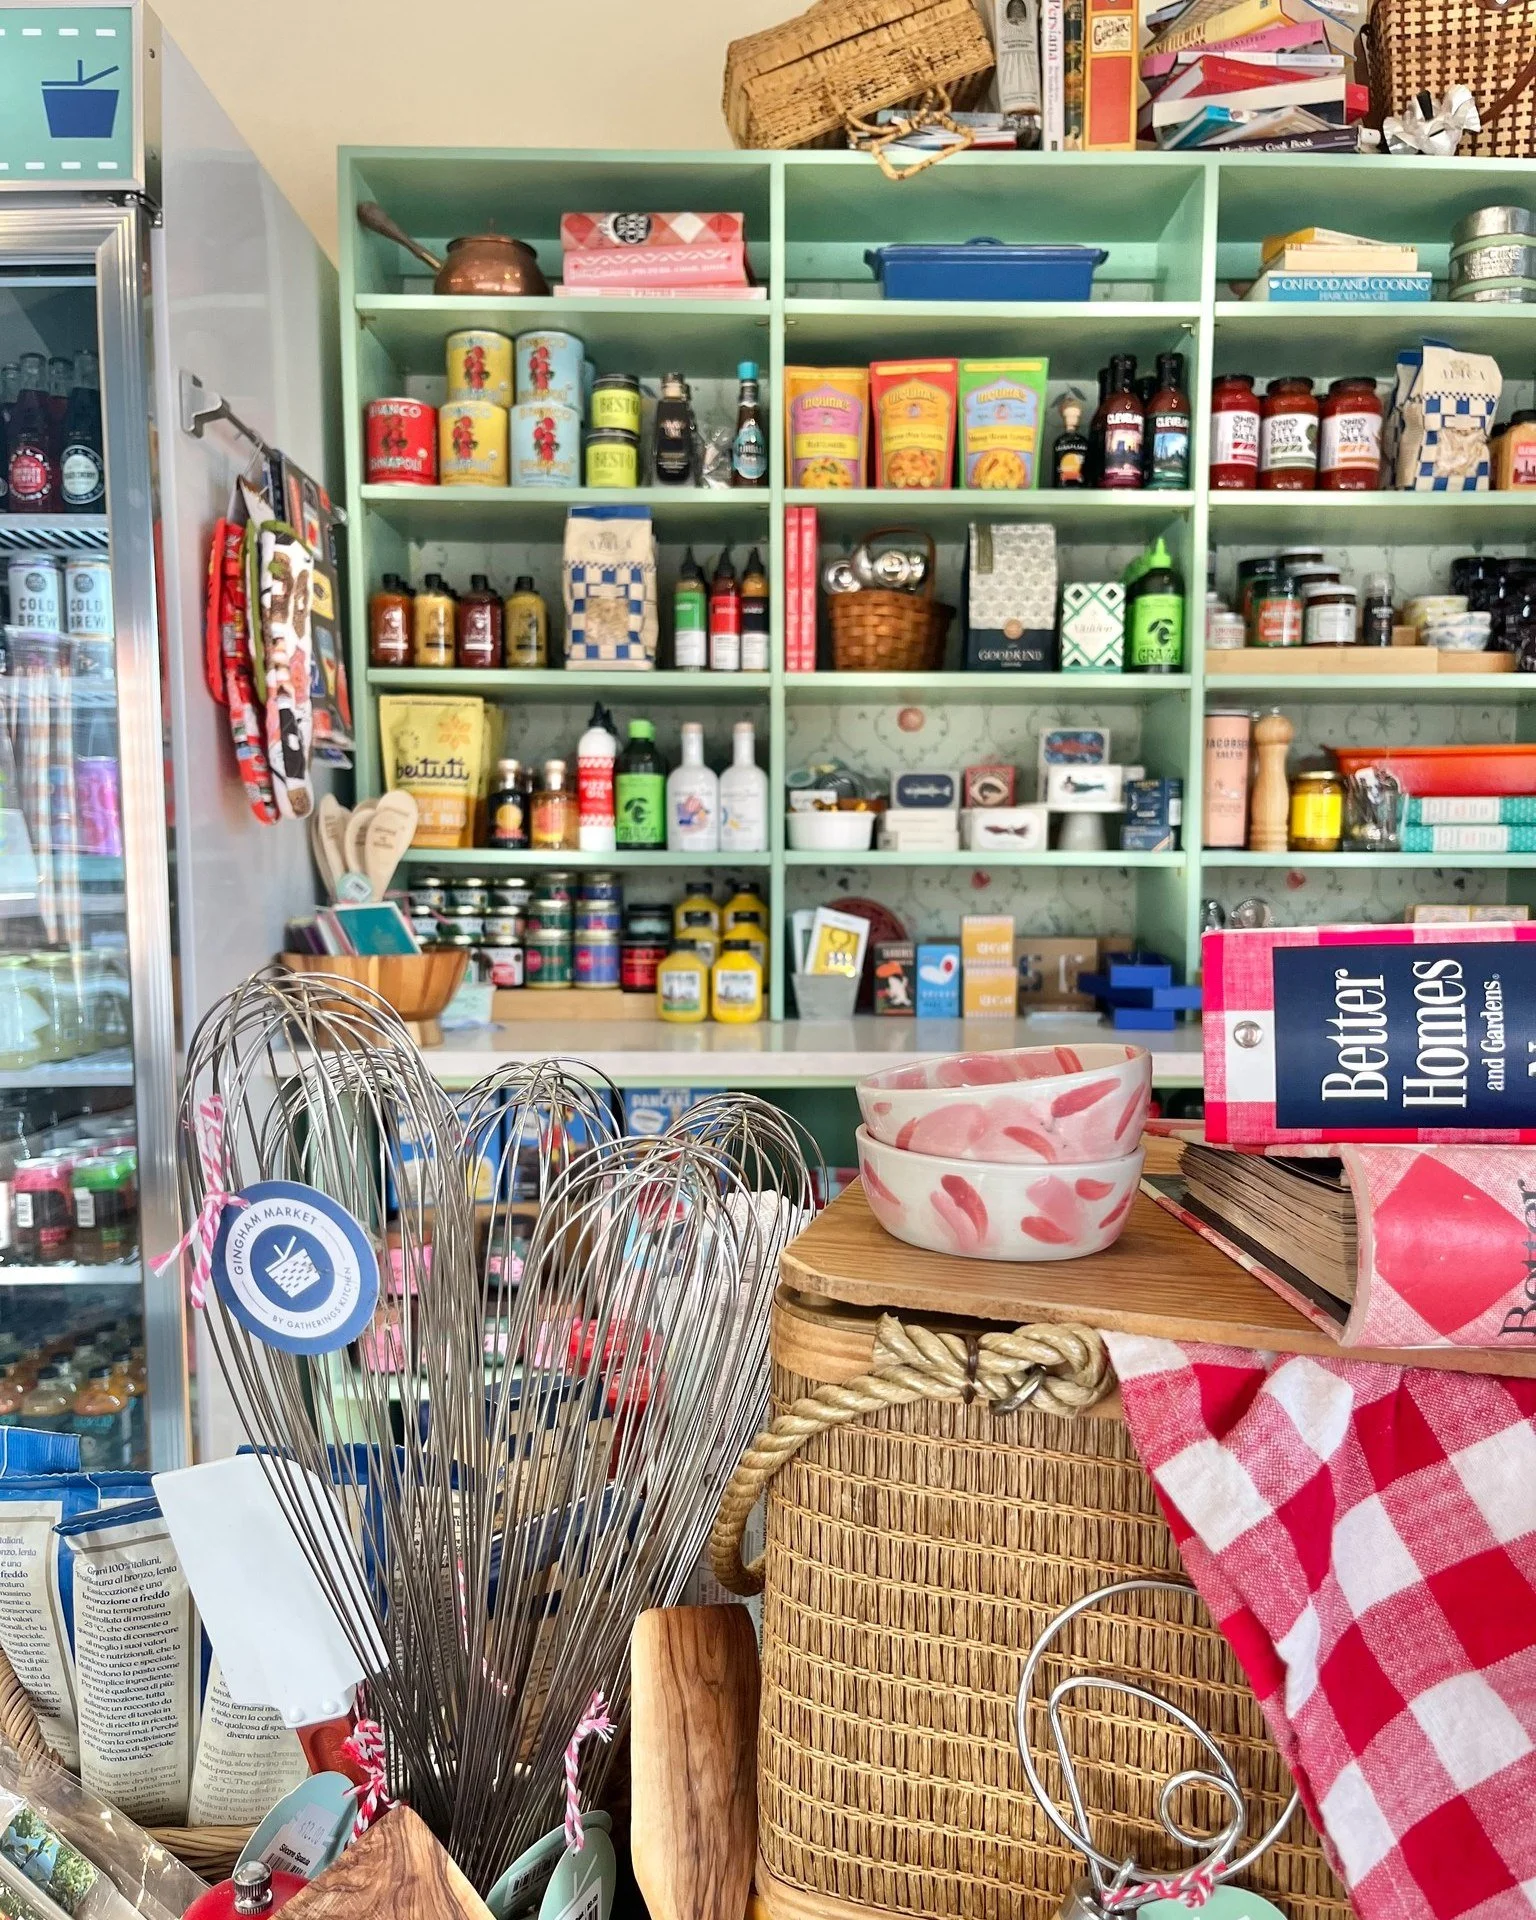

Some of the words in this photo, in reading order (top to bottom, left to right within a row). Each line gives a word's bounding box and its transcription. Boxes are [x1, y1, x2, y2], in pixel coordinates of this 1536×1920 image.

[1282, 279, 1304, 291] ON
[1304, 279, 1341, 291] FOOD
[1340, 279, 1369, 291] AND
[1370, 278, 1429, 291] COOKING
[1321, 968, 1389, 1101] Better
[1403, 959, 1469, 1108] Homes
[1481, 1057, 1505, 1091] and
[233, 1211, 262, 1276] GINGHAM
[263, 1206, 319, 1226] MARKET
[272, 1314, 285, 1325] BY
[286, 1307, 342, 1330] GATHERINGS
[338, 1266, 352, 1308] KITCHEN
[0, 1571, 29, 1579] freddo
[115, 1576, 123, 1584] al
[124, 1571, 155, 1582] bronzo,
[156, 1565, 177, 1576] lento
[146, 1580, 163, 1589] una
[140, 1590, 170, 1602] freddo
[86, 1604, 95, 1612] ad
[113, 1602, 166, 1614] temperatura
[123, 1614, 132, 1623] di
[132, 1611, 171, 1622] massimo
[123, 1621, 161, 1632] consente
[99, 1634, 122, 1642] pasta
[123, 1633, 131, 1641] di
[132, 1627, 179, 1640] conservare
[93, 1642, 119, 1652] meglio
[124, 1642, 142, 1650] suoi
[143, 1638, 167, 1647] valori
[156, 1646, 172, 1654] che
[93, 1668, 122, 1677] vedono
[132, 1667, 156, 1676] pasta
[156, 1662, 180, 1672] come
[91, 1675, 125, 1686] semplice
[111, 1686, 149, 1696] qualcosa
[150, 1681, 158, 1689] di
[146, 1691, 165, 1700] tutta
[124, 1701, 160, 1711] racconto
[210, 1696, 230, 1708] senza
[231, 1702, 264, 1712] fermarsi
[85, 1707, 127, 1720] condividere
[137, 1708, 161, 1717] tavola
[216, 1709, 231, 1718] solo
[114, 1721, 140, 1729] ricetta
[211, 1716, 224, 1725] che
[224, 1720, 260, 1731] qualcosa
[261, 1723, 269, 1731] di
[98, 1728, 131, 1737] fermarsi
[125, 1731, 176, 1745] condivisione
[226, 1731, 255, 1740] diventa
[96, 1744, 131, 1755] qualcosa
[140, 1740, 174, 1751] speciale
[100, 1754, 128, 1762] diventa
